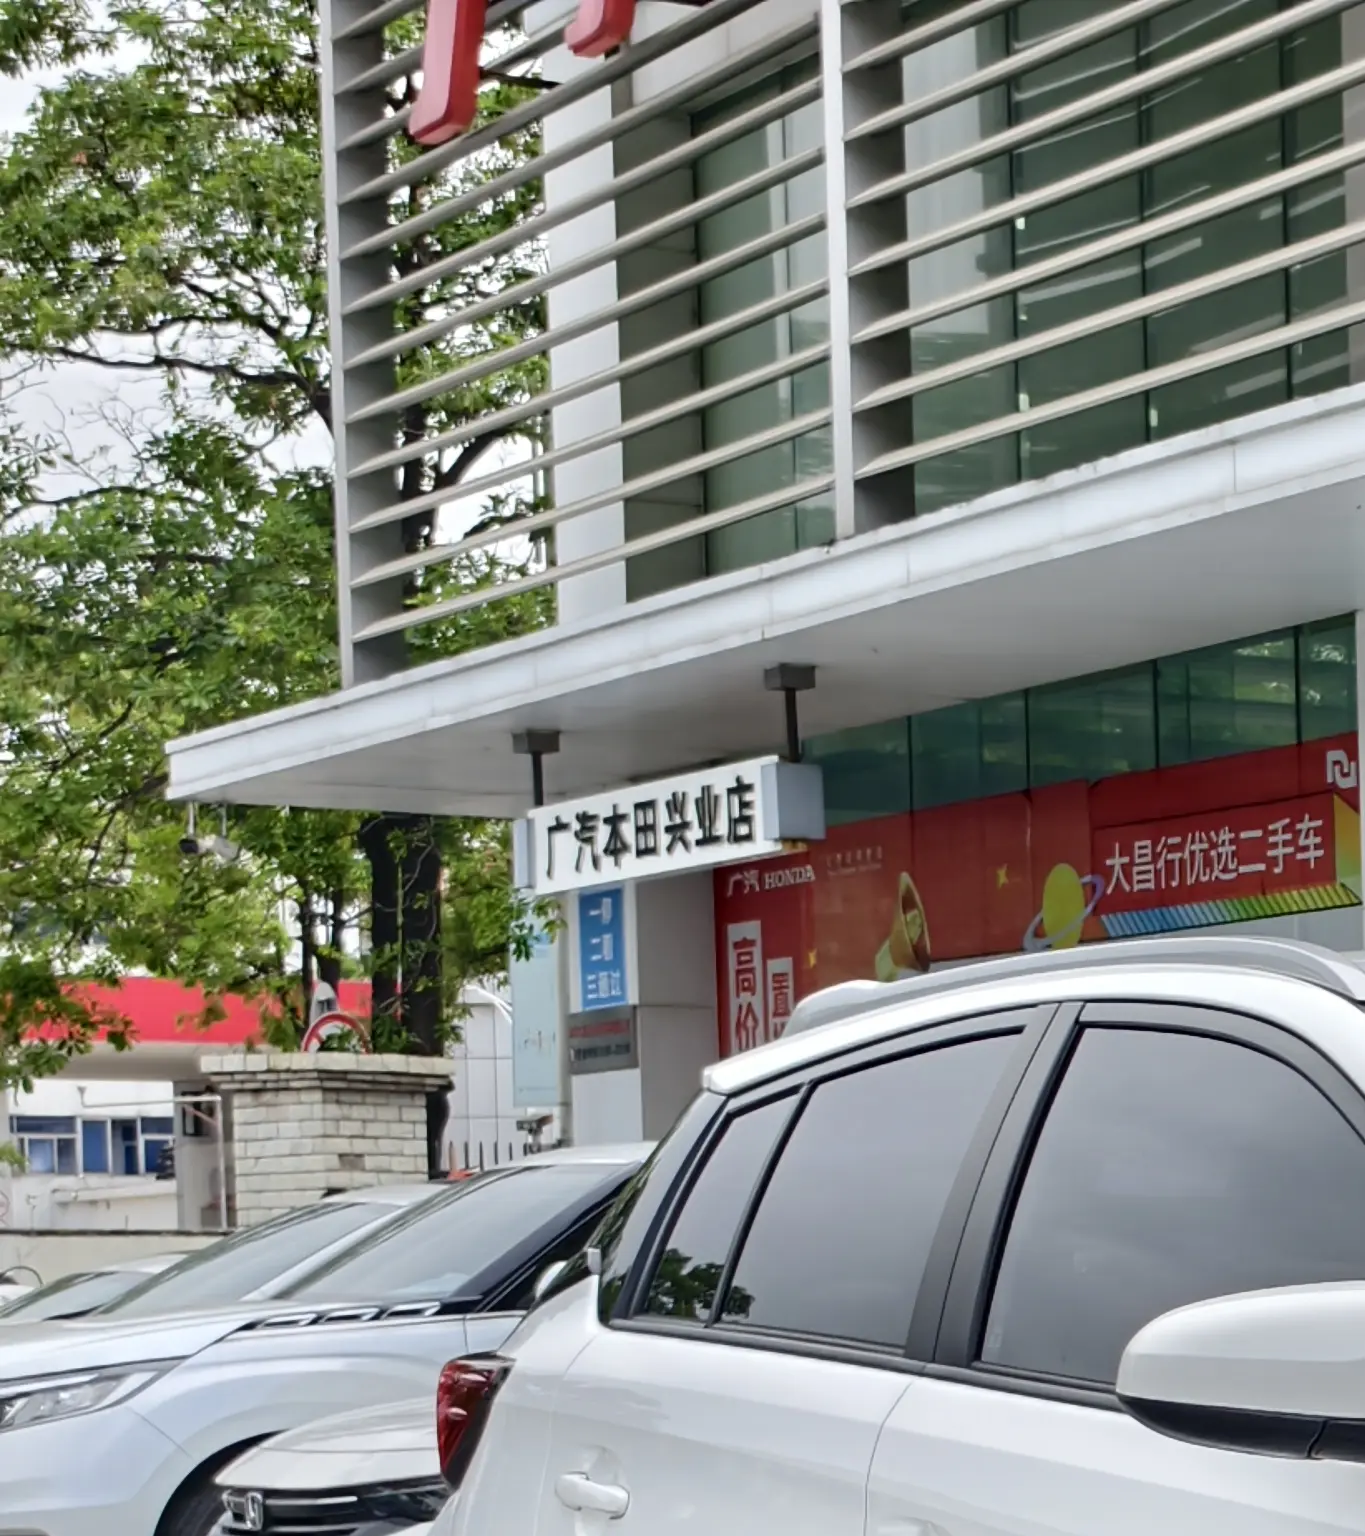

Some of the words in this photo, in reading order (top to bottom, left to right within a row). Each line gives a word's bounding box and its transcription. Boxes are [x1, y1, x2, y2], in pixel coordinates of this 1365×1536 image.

[546, 774, 757, 881] 广汽本田兴业店
[1104, 812, 1325, 895] 大昌行优选二手车
[764, 864, 816, 890] HONDA
[732, 936, 759, 1050] 高价
